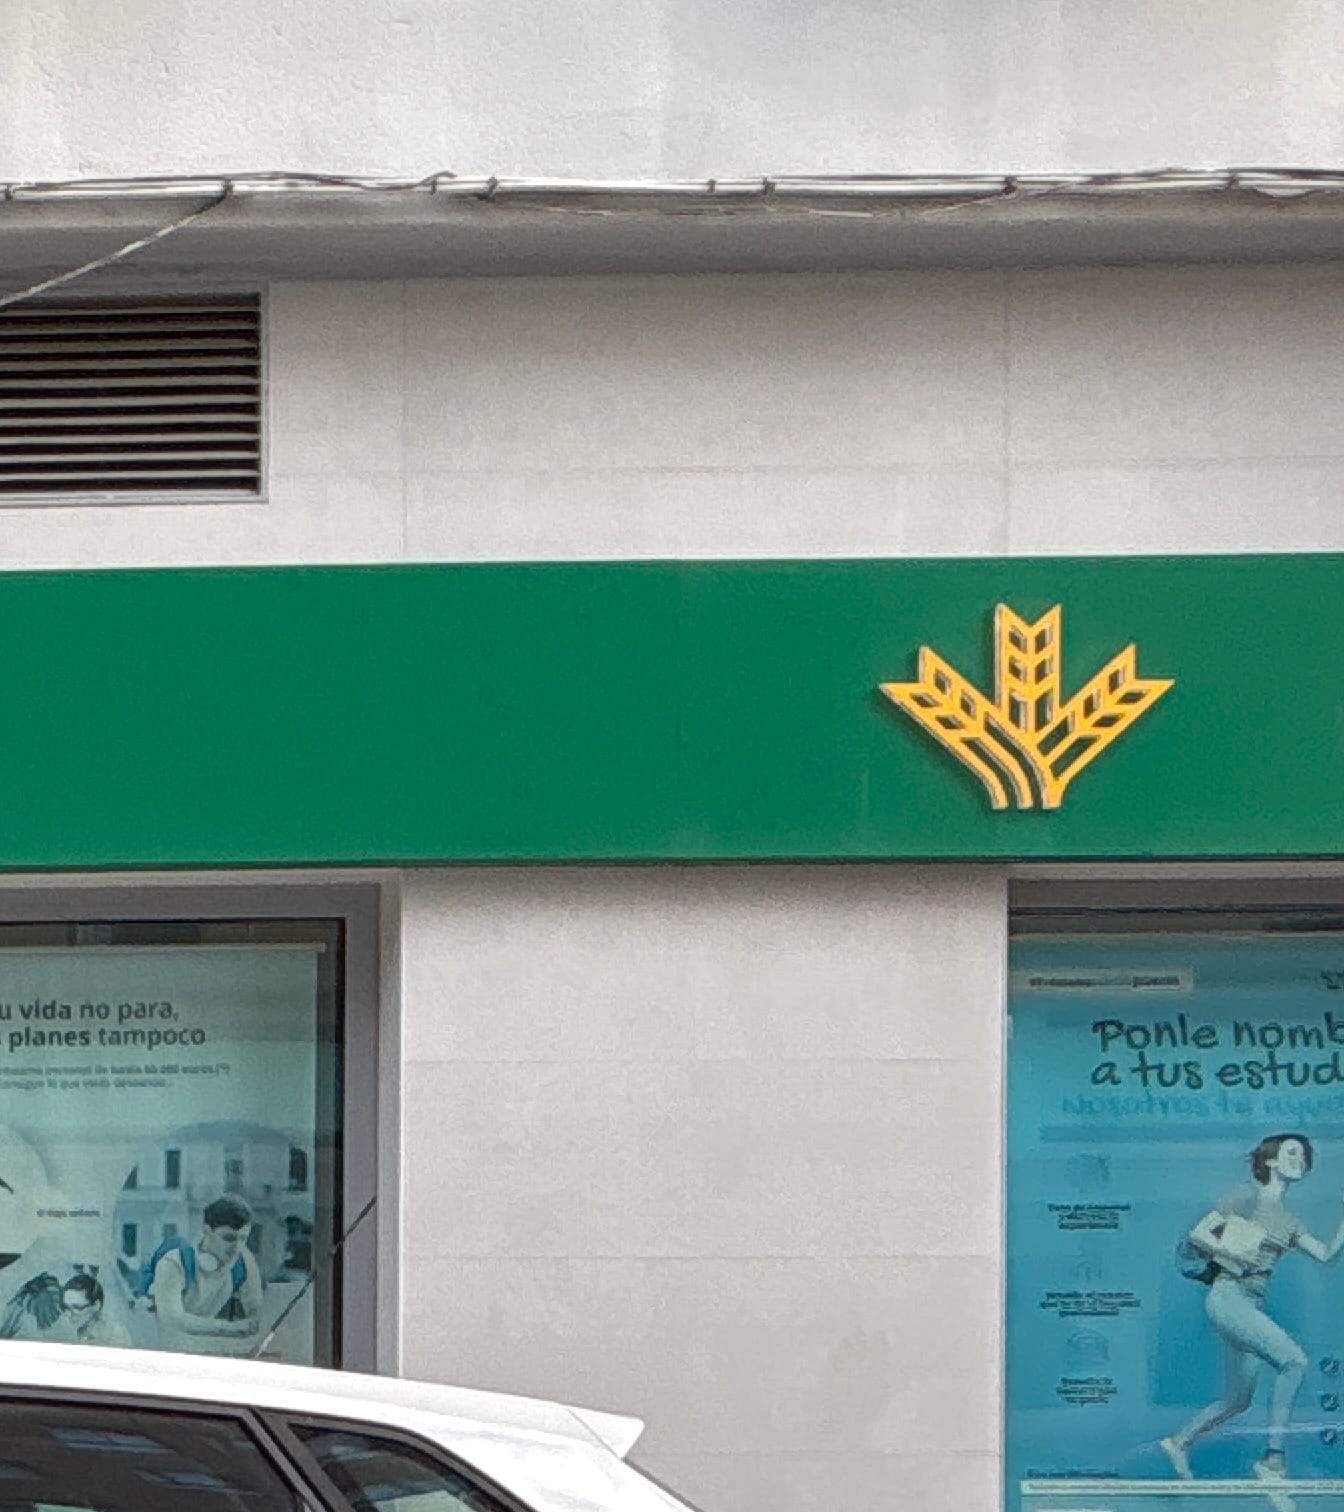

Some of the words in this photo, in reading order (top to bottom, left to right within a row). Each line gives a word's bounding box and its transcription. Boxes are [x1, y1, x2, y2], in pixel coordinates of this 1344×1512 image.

[19, 999, 72, 1021] vida
[80, 1002, 111, 1021] no
[118, 1001, 180, 1025] para,
[9, 1027, 90, 1052] planes
[98, 1027, 206, 1051] tampoco
[1092, 1013, 1220, 1053] Ponle
[1091, 1061, 1122, 1086] a
[1130, 1051, 1205, 1090] tus
